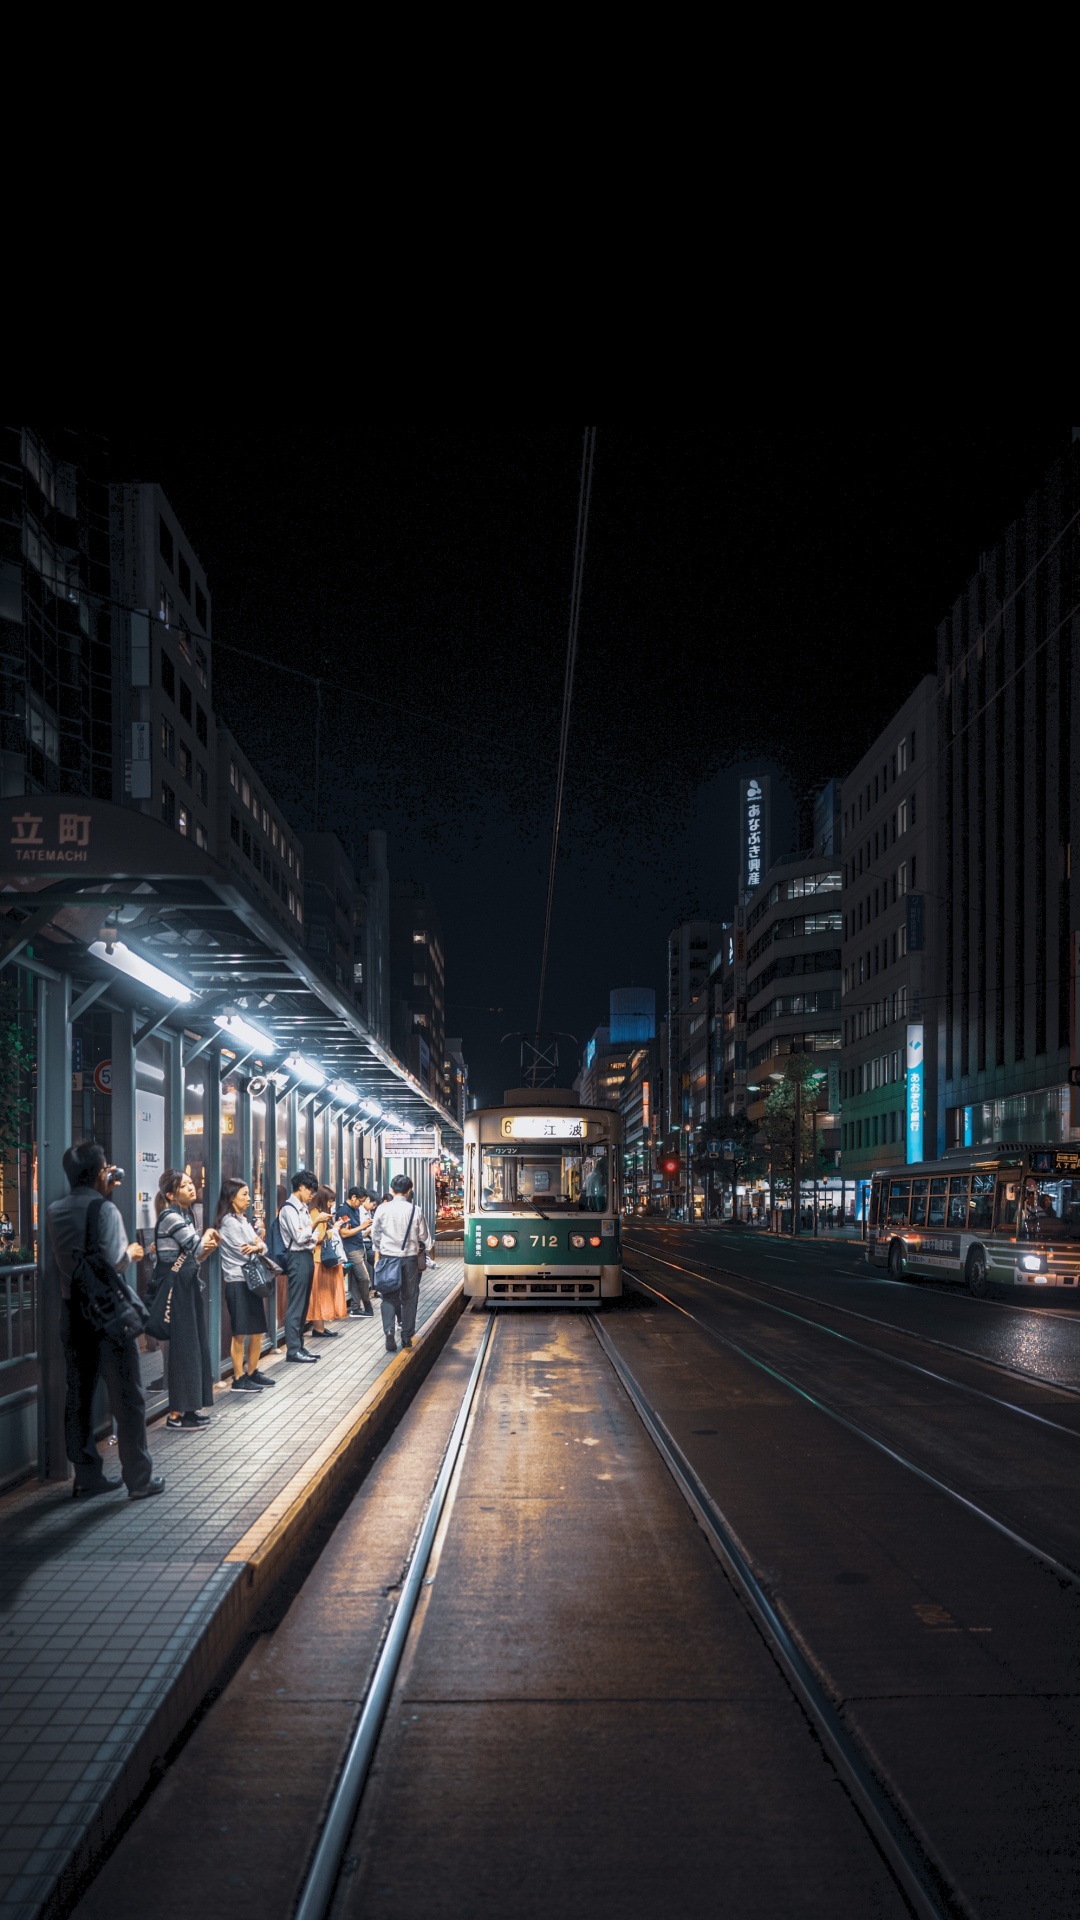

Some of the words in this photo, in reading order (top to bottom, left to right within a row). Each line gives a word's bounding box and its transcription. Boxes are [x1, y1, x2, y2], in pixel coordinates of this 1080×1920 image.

[10, 811, 92, 846] 立町
[747, 804, 761, 886] あなぶき興産
[15, 849, 88, 861] TATEMACHI
[910, 1072, 921, 1132] あおぞら銀行
[504, 1120, 512, 1134] 6
[543, 1124, 583, 1136] 江波
[529, 1235, 558, 1248] 712
